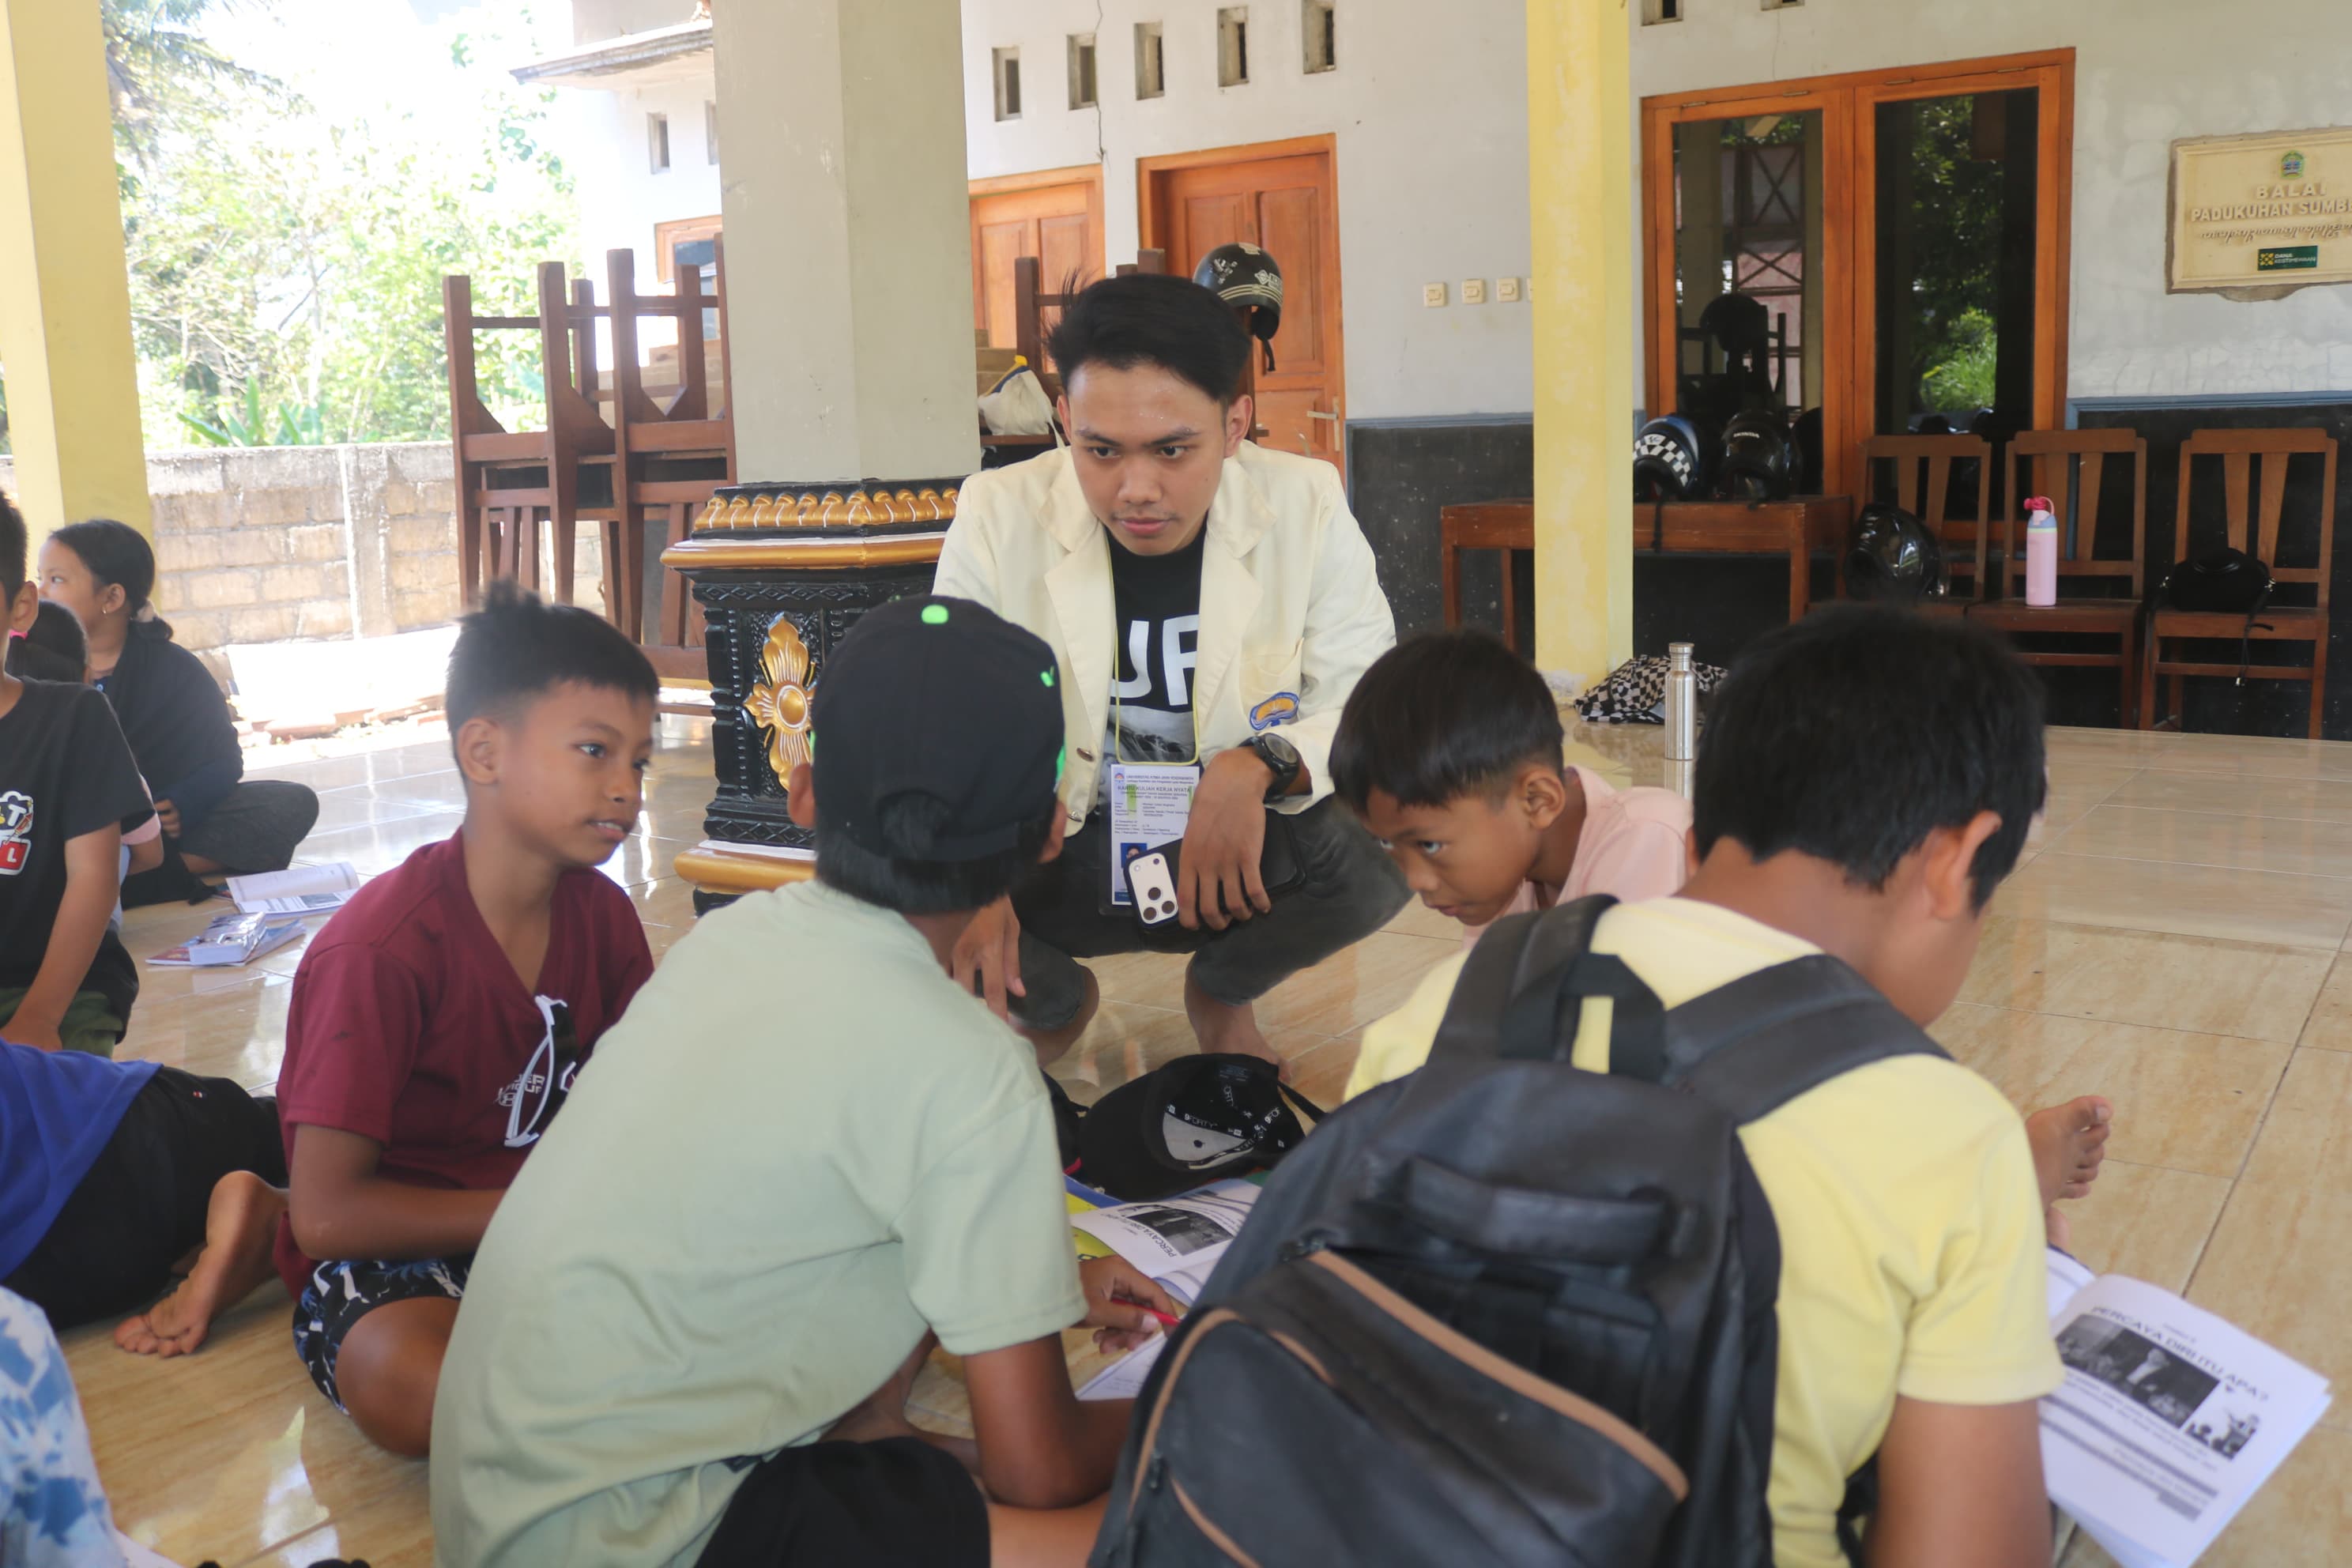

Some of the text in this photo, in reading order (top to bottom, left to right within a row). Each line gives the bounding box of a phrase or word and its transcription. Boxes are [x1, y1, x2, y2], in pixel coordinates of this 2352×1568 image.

[2256, 182, 2327, 198] BALAI
[2191, 202, 2291, 222] PADUKUHAN
[1144, 1228, 1177, 1257] PERCAYA
[2092, 1306, 2162, 1341] PERCAYA
